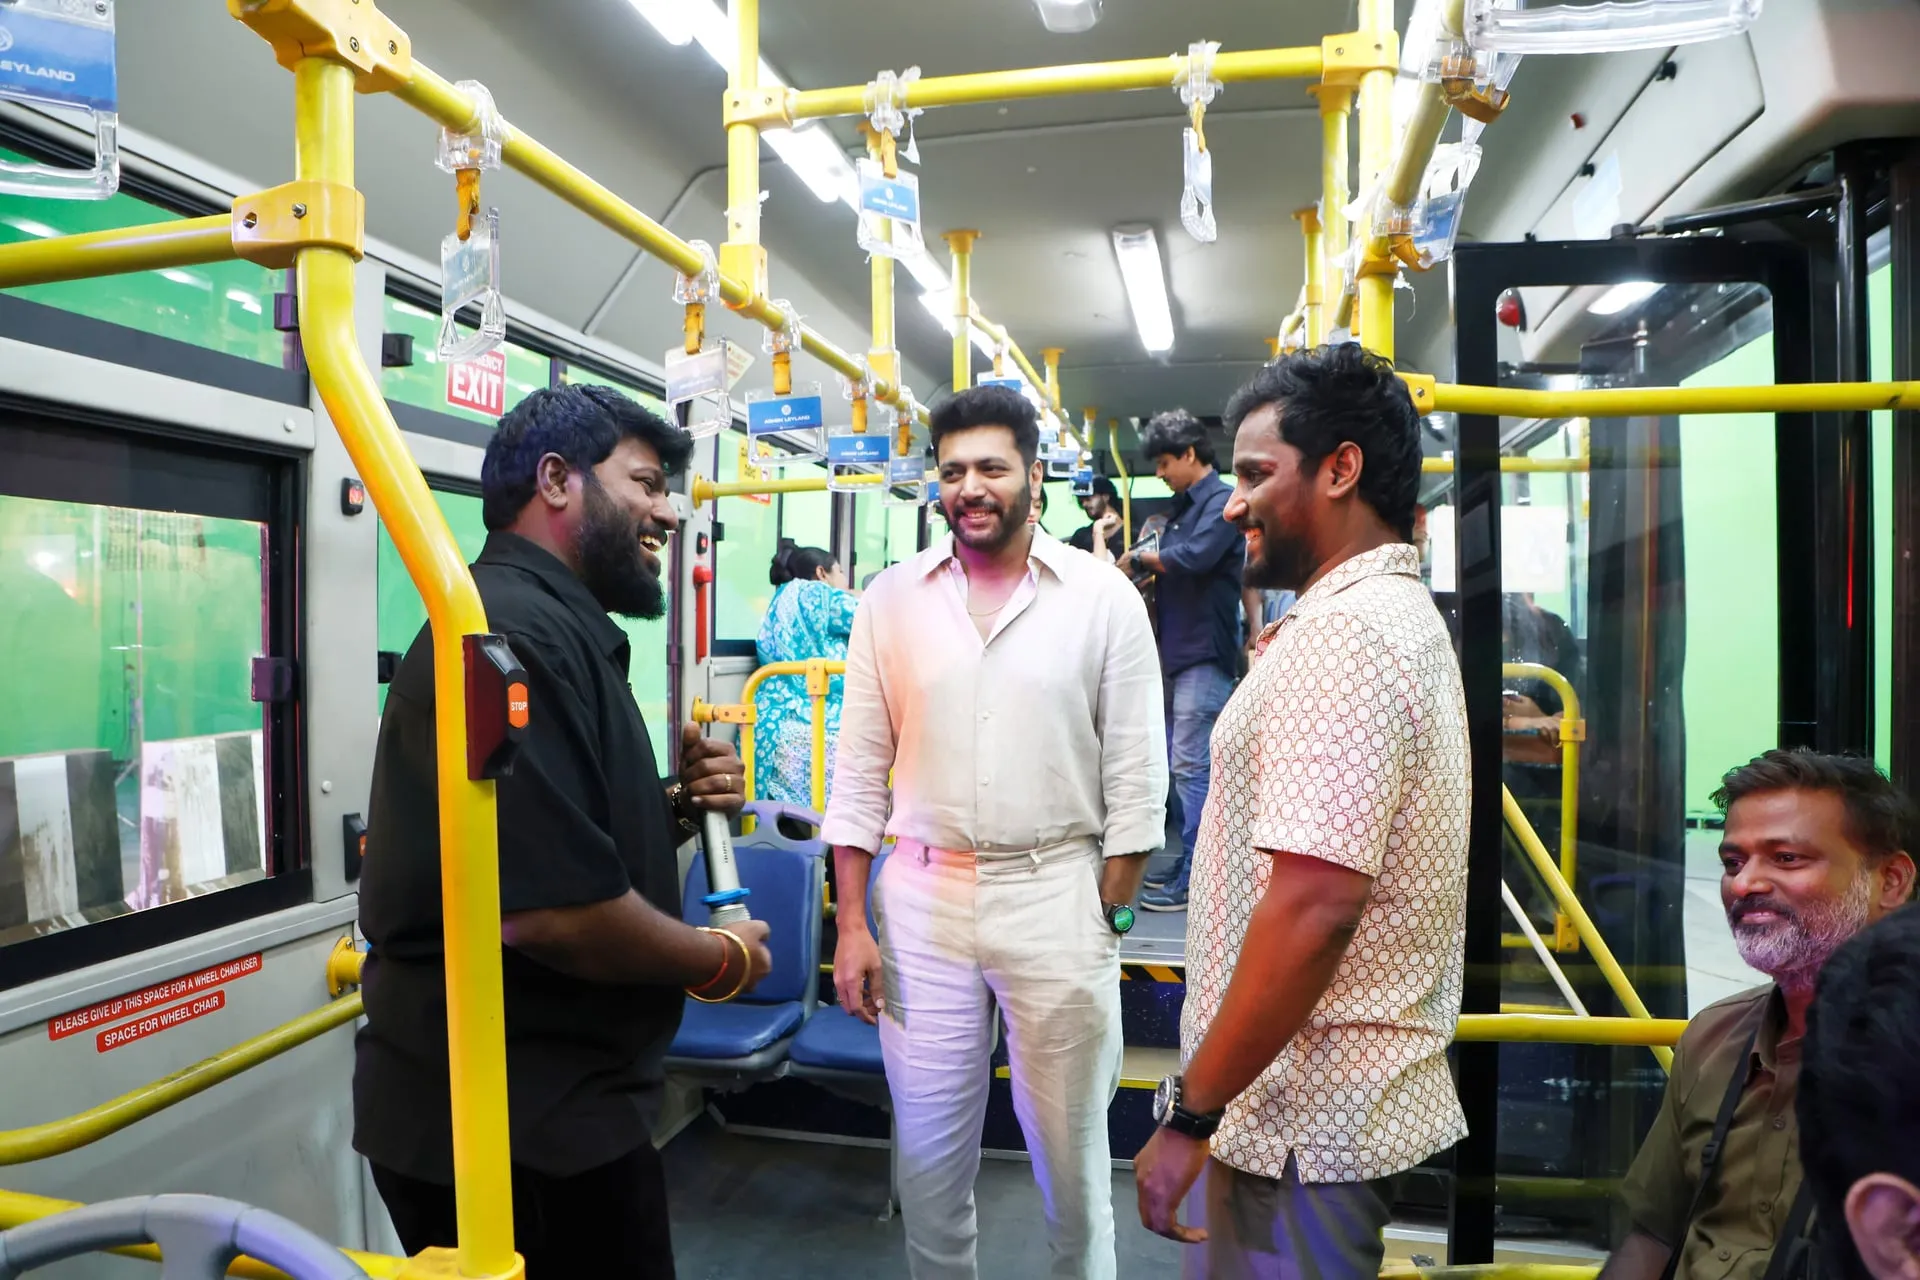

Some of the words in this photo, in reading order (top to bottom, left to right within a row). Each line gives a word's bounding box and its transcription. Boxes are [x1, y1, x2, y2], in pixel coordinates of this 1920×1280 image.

[0, 60, 75, 81] EYLAND
[452, 362, 502, 409] EXIT
[511, 701, 528, 711] STOP
[55, 1012, 89, 1033] PLEASE
[90, 1005, 110, 1021] GIVE
[111, 1002, 123, 1014] UP
[124, 995, 142, 1010] THIS
[144, 986, 170, 1004] SPACE
[171, 980, 187, 995] FOR
[188, 979, 194, 989] A
[195, 971, 220, 986] WHEEL
[220, 963, 241, 978] CHAIR
[241, 957, 258, 972] USER
[104, 1025, 137, 1046] SPACE
[140, 1018, 158, 1034] FOR
[160, 1007, 192, 1026] WHEEL
[193, 996, 219, 1014] CHAIR
